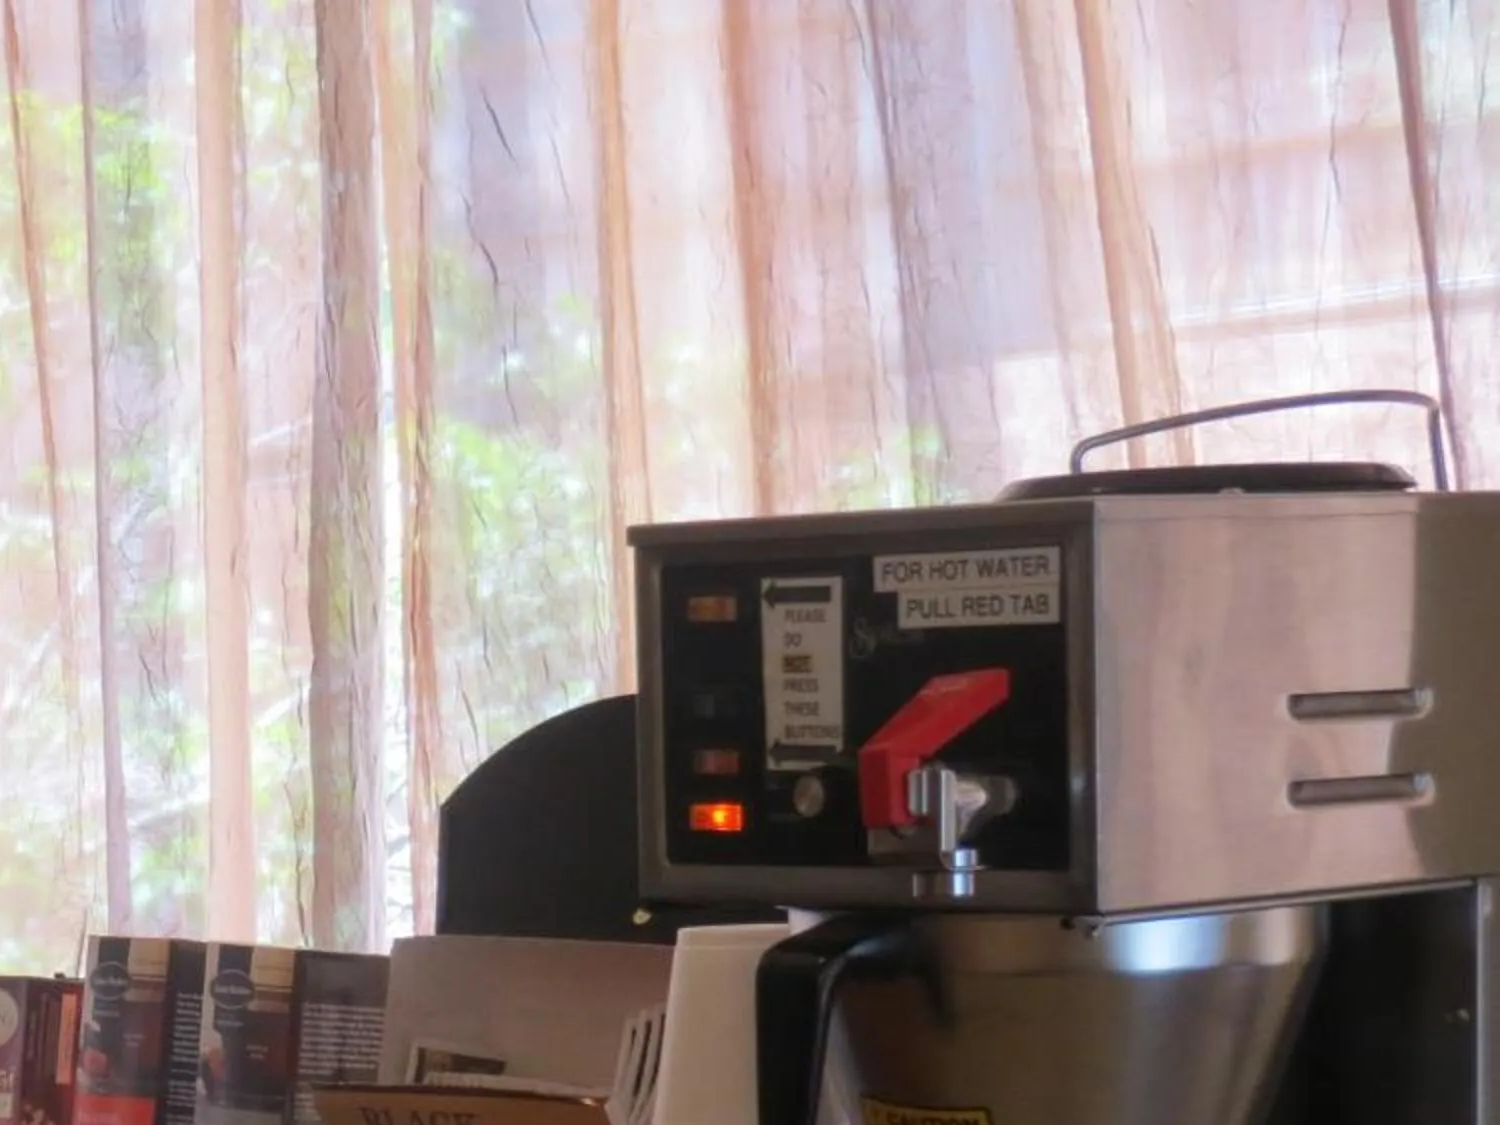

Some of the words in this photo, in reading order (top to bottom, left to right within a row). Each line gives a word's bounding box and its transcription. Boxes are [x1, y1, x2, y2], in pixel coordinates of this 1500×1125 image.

[881, 561, 923, 583] FOR
[929, 559, 968, 580] HOT
[976, 554, 1049, 578] WATER
[906, 596, 955, 619] PULL
[962, 595, 1005, 617] RED
[1009, 592, 1049, 615] TAB
